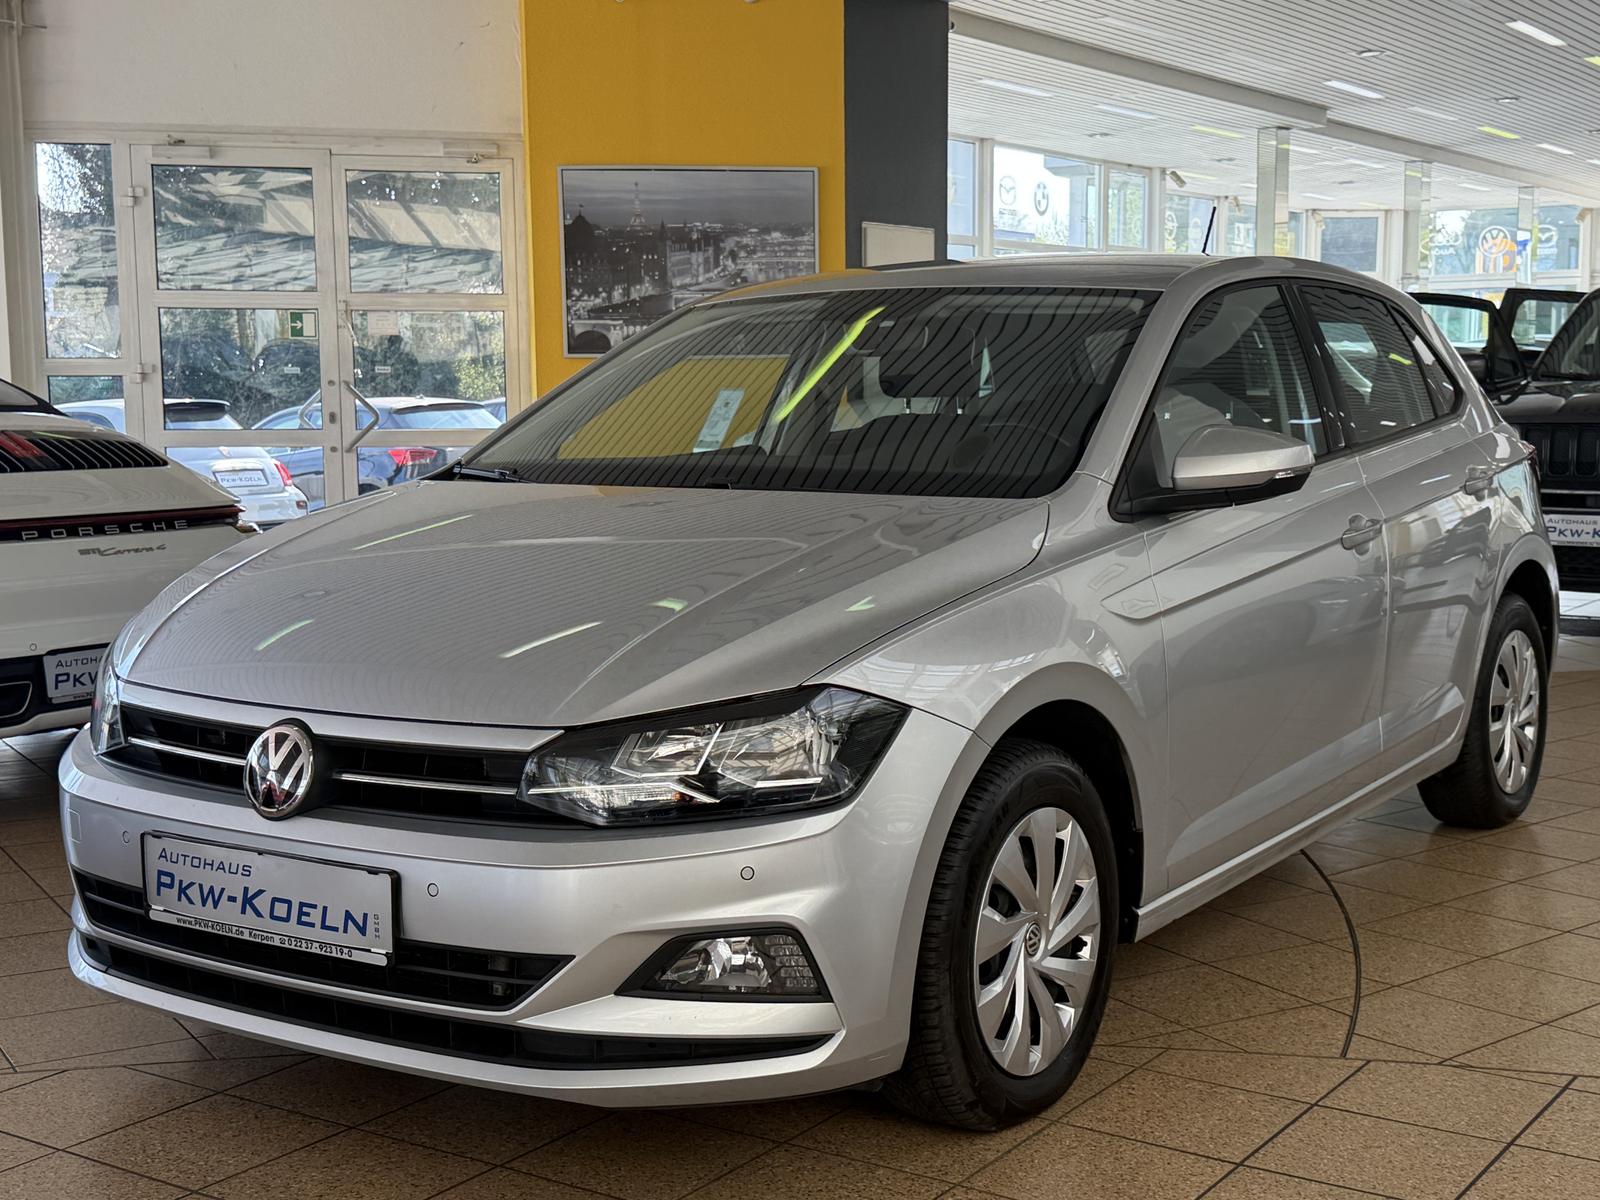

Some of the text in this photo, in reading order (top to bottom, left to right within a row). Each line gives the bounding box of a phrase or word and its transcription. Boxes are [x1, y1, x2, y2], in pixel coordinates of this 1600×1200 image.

[21, 519, 189, 542] PORSCHE
[1547, 517, 1598, 526] AUTOHAUS
[55, 655, 103, 669] AUTOH
[158, 847, 252, 877] AUTOHAUS
[156, 869, 369, 937] PKW-KOELN
[176, 917, 245, 937] www.PKW-KOELN.de
[248, 930, 275, 944] Kerpen
